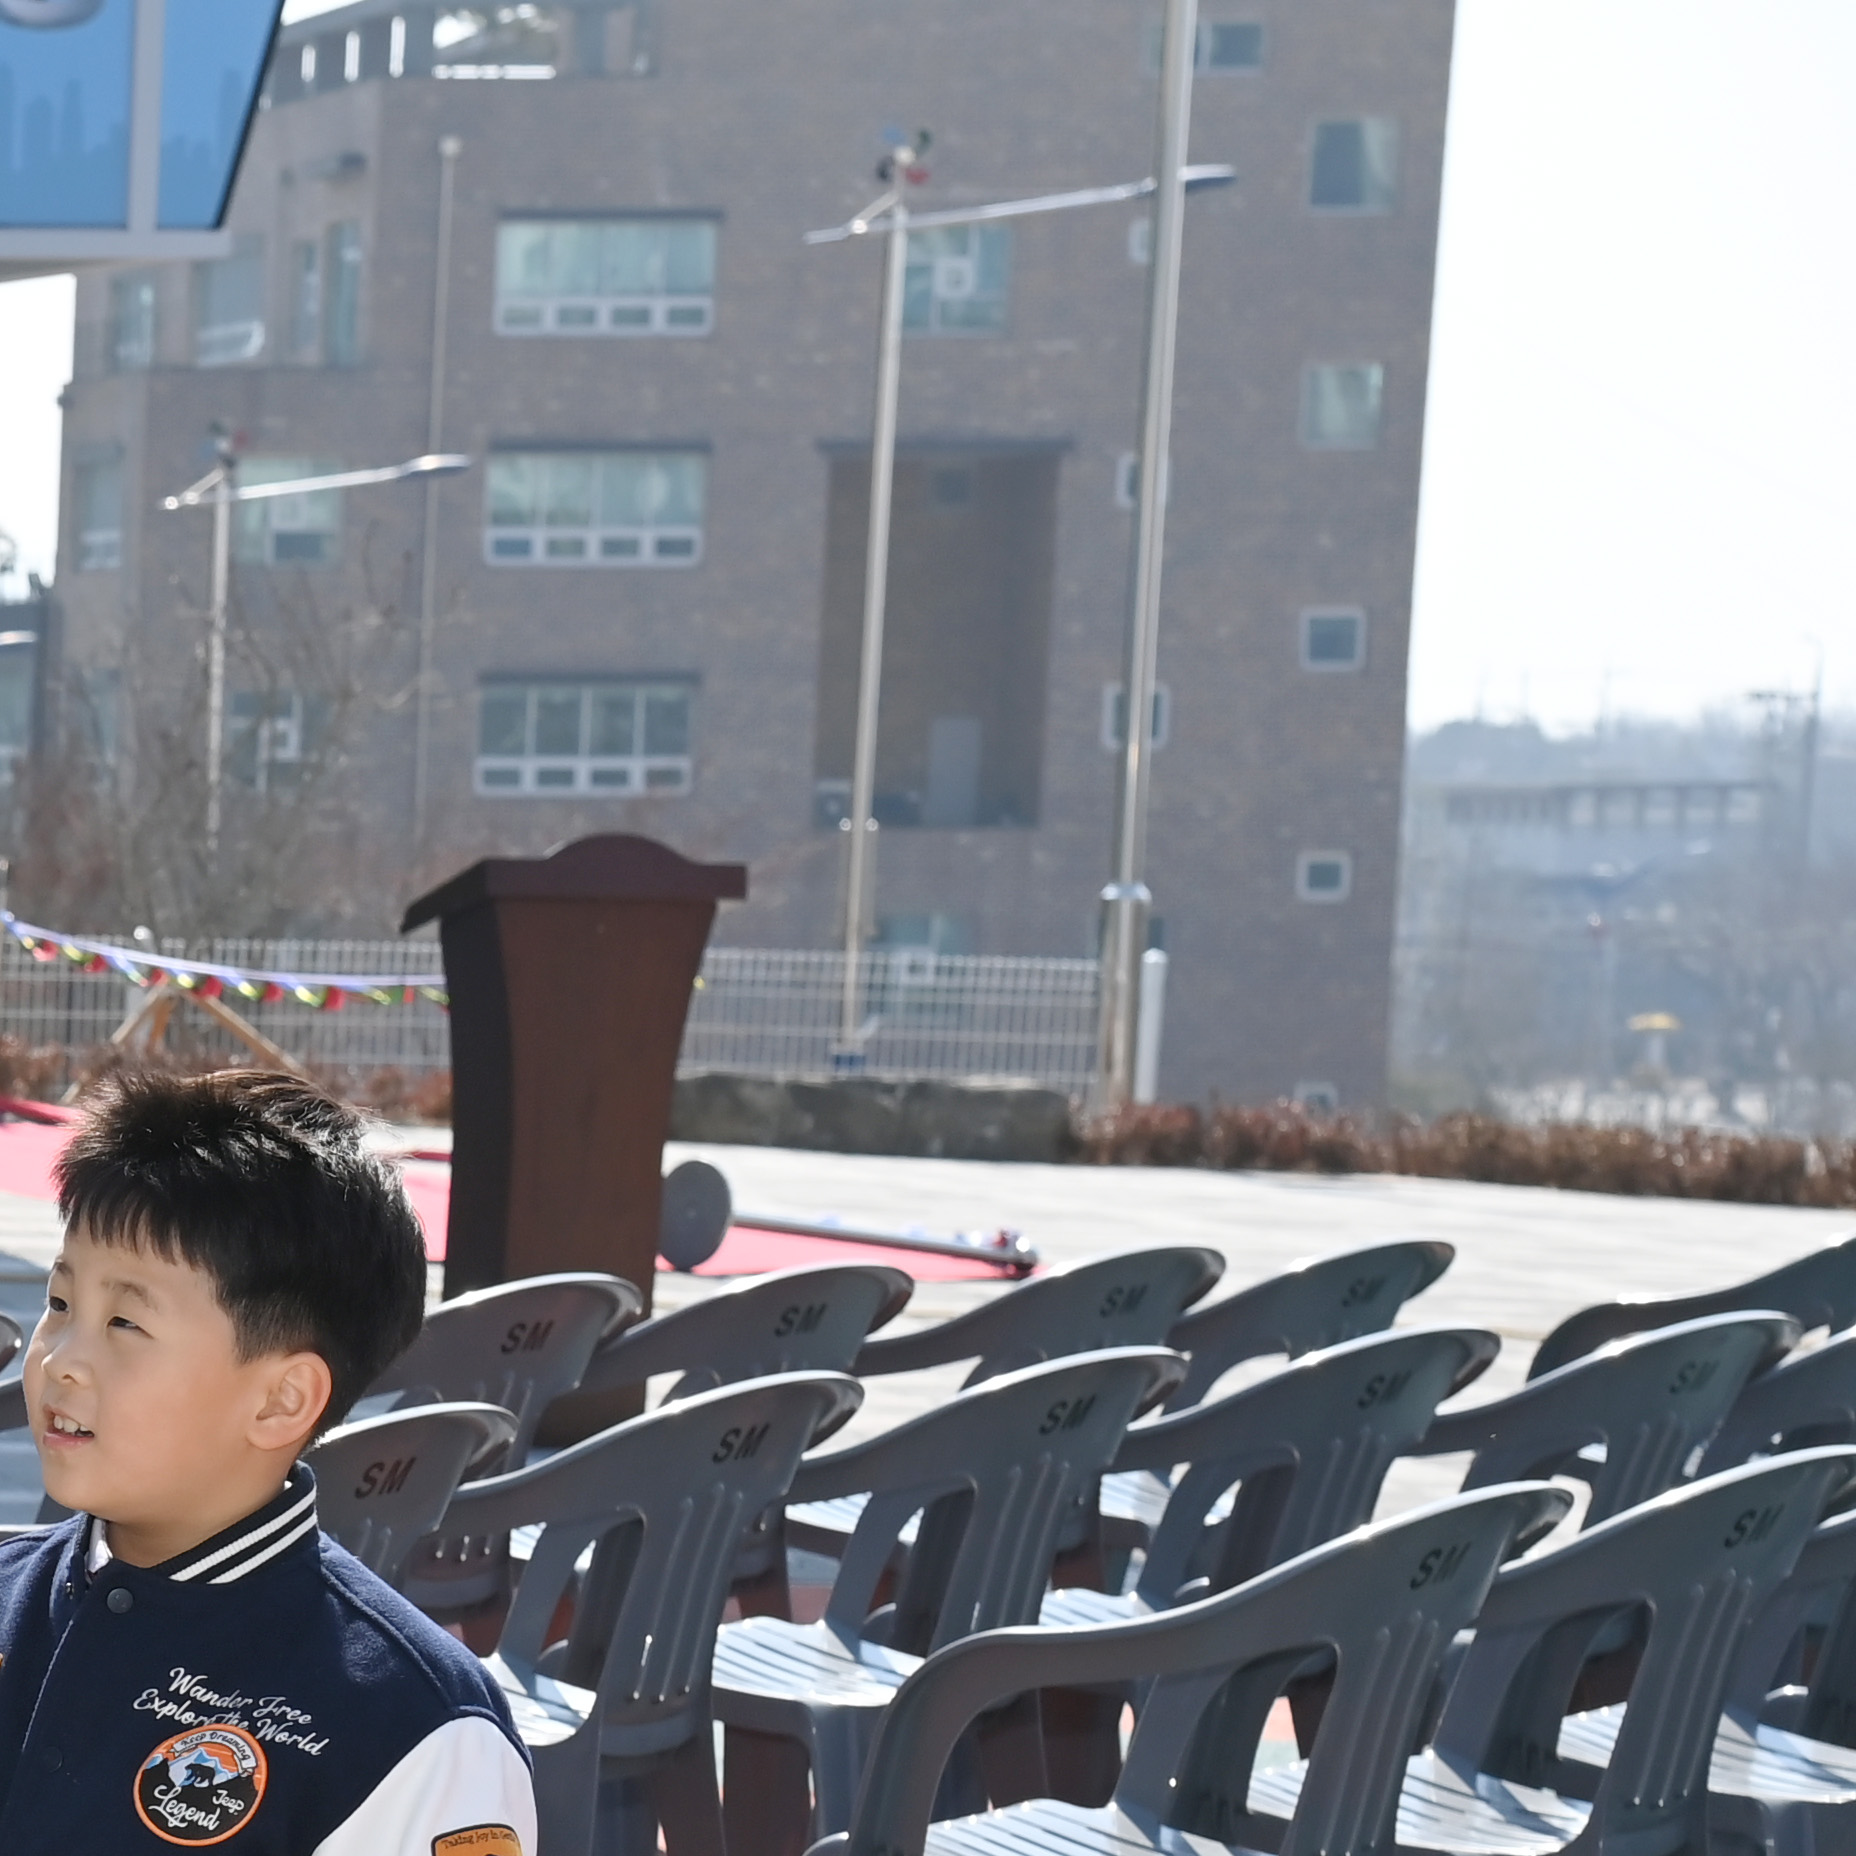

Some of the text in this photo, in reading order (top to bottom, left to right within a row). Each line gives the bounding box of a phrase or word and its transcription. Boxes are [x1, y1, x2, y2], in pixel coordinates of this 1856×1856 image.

[774, 1302, 827, 1338] SM
[1100, 1284, 1149, 1319] SM
[499, 1319, 555, 1355] SM
[1039, 1394, 1097, 1435] SM
[713, 1422, 771, 1464] SM
[353, 1456, 417, 1500] SM
[1409, 1541, 1472, 1592] SM
[169, 1666, 313, 1726] Wander Free
[208, 1731, 253, 1762] Dreaming
[256, 1718, 330, 1757] World
[148, 1784, 221, 1832] Legend
